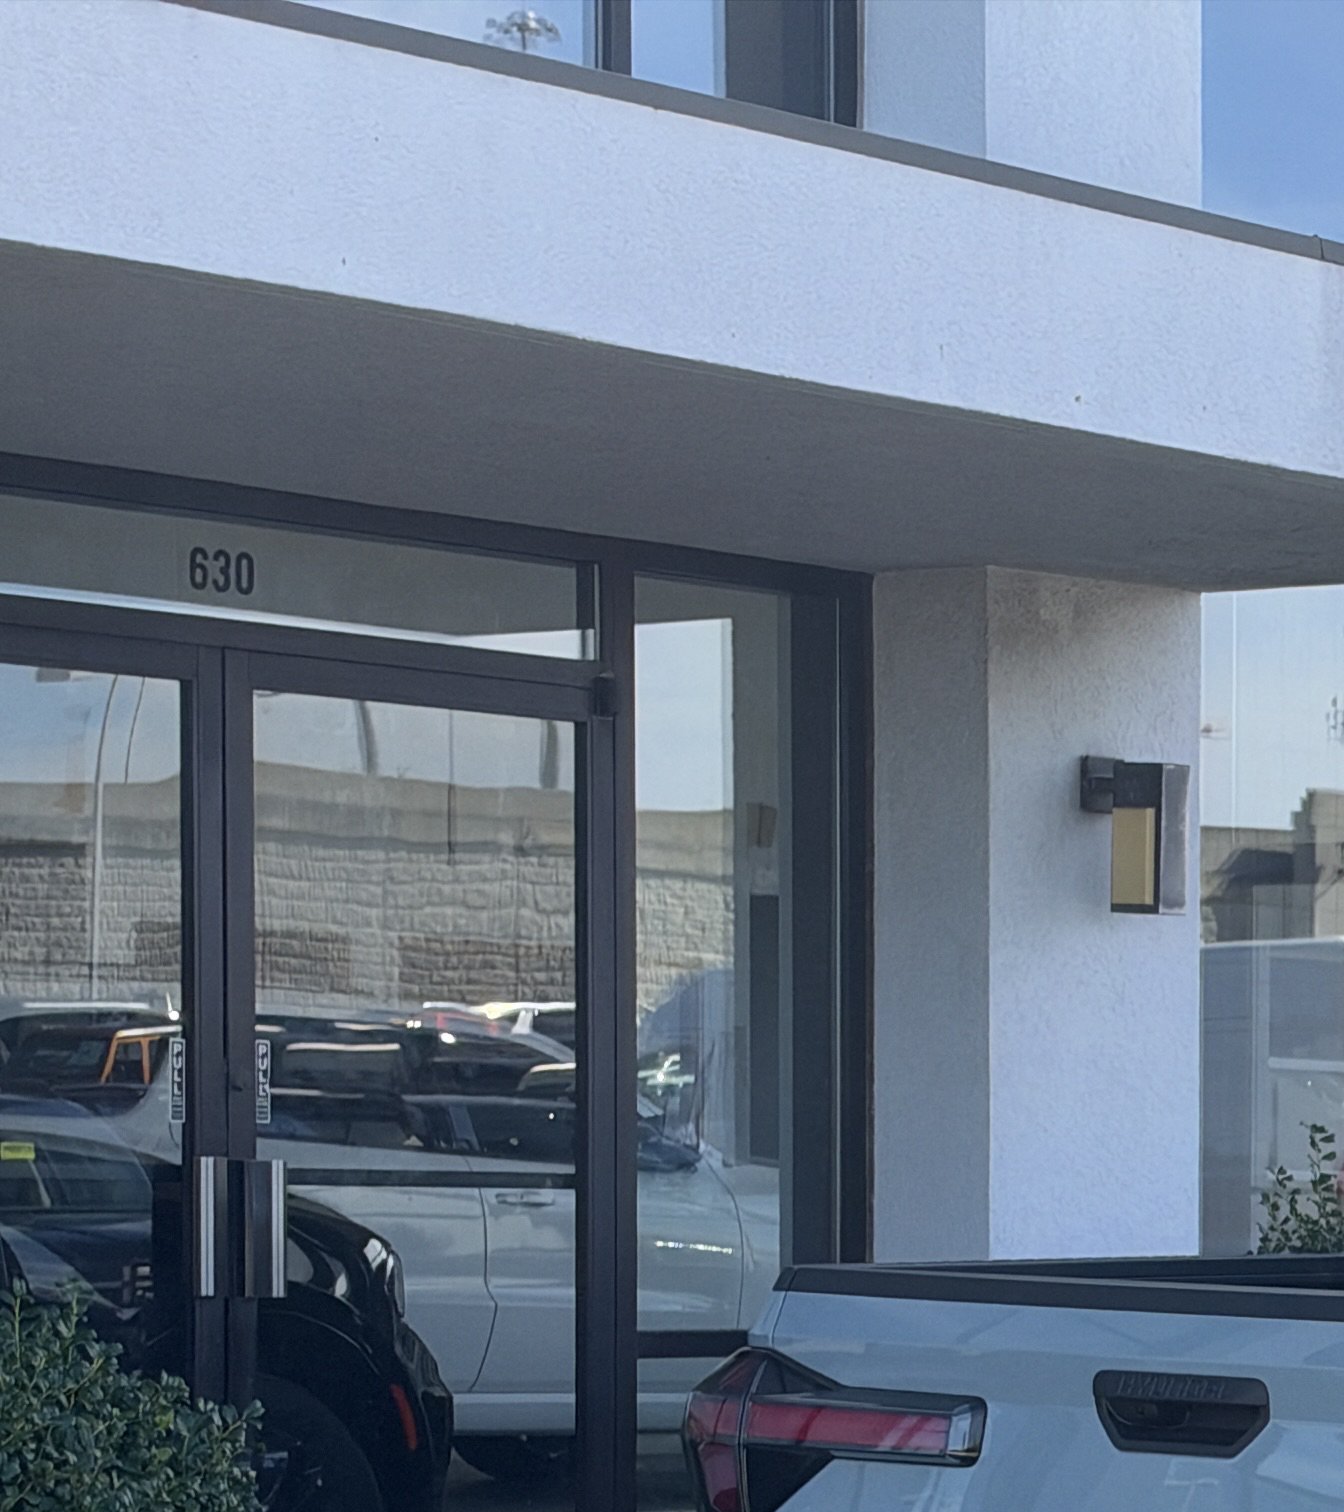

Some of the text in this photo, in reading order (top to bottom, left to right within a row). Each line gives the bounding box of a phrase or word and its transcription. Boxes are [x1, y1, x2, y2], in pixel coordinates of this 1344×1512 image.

[189, 546, 255, 596] 630
[172, 1043, 183, 1096] PULL
[258, 1044, 269, 1097] PULL
